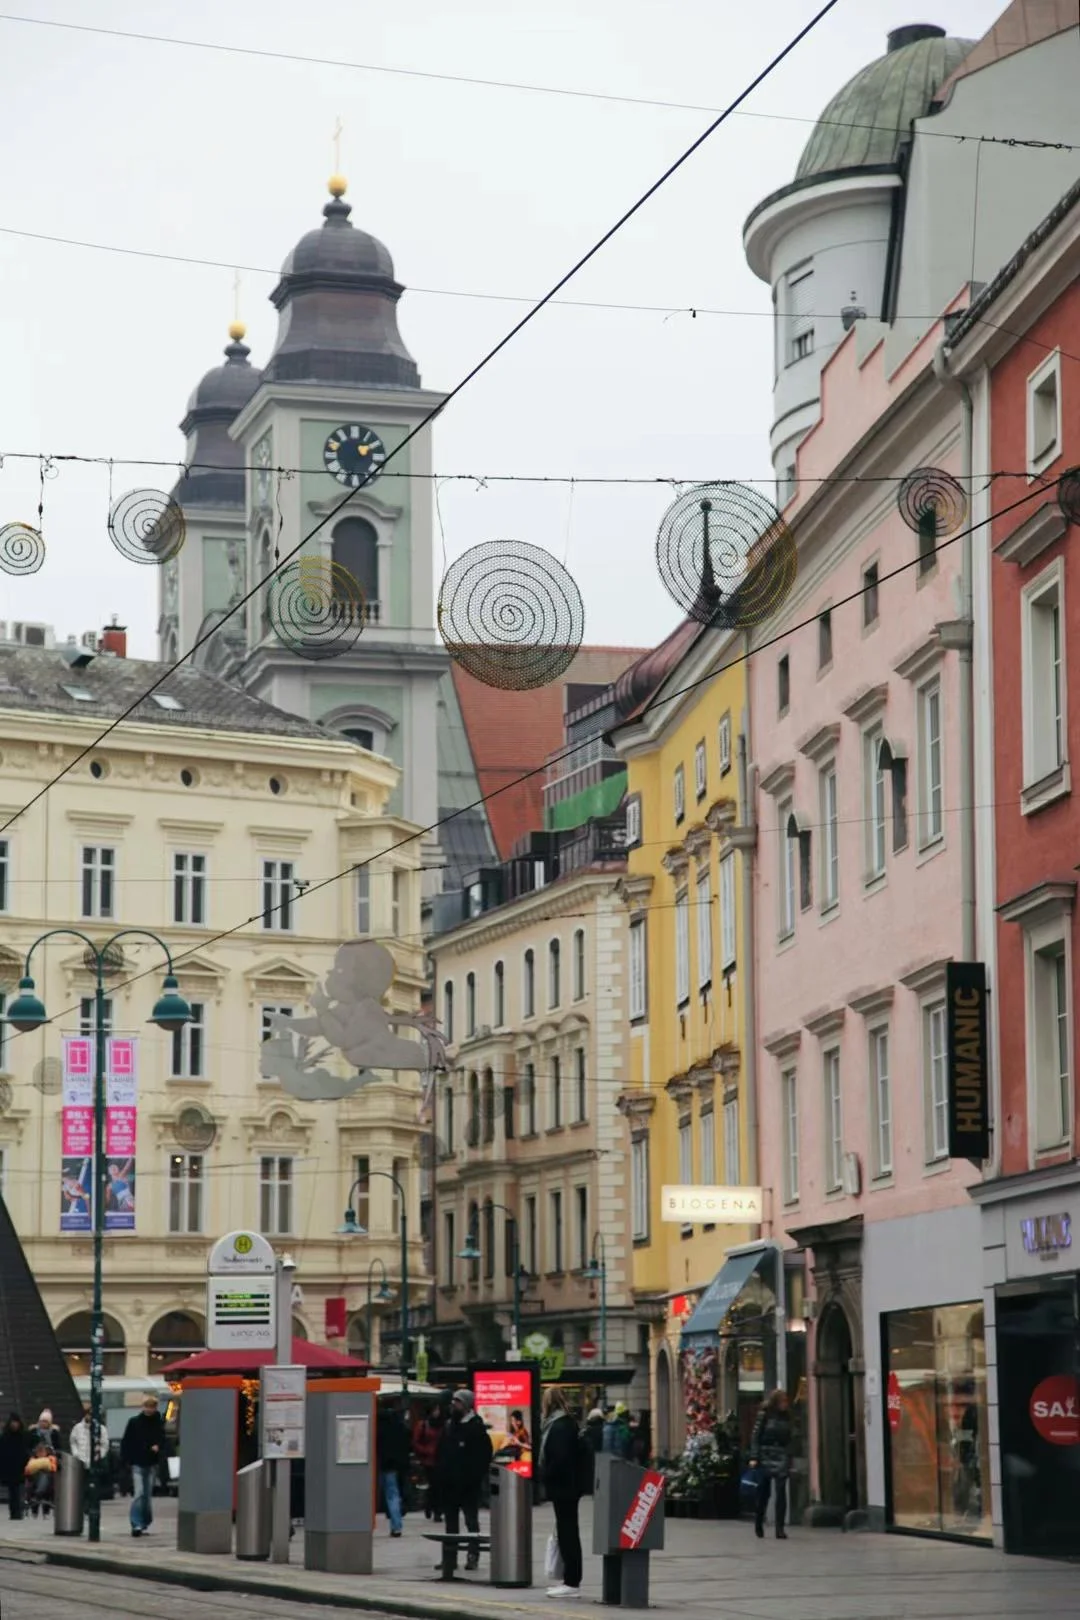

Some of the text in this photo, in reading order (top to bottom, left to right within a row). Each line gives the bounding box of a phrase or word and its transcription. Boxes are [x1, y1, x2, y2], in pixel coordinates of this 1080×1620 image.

[954, 987, 983, 1133] HUMANIC
[669, 1198, 757, 1210] BIOGENA
[621, 1482, 658, 1540] Heute
